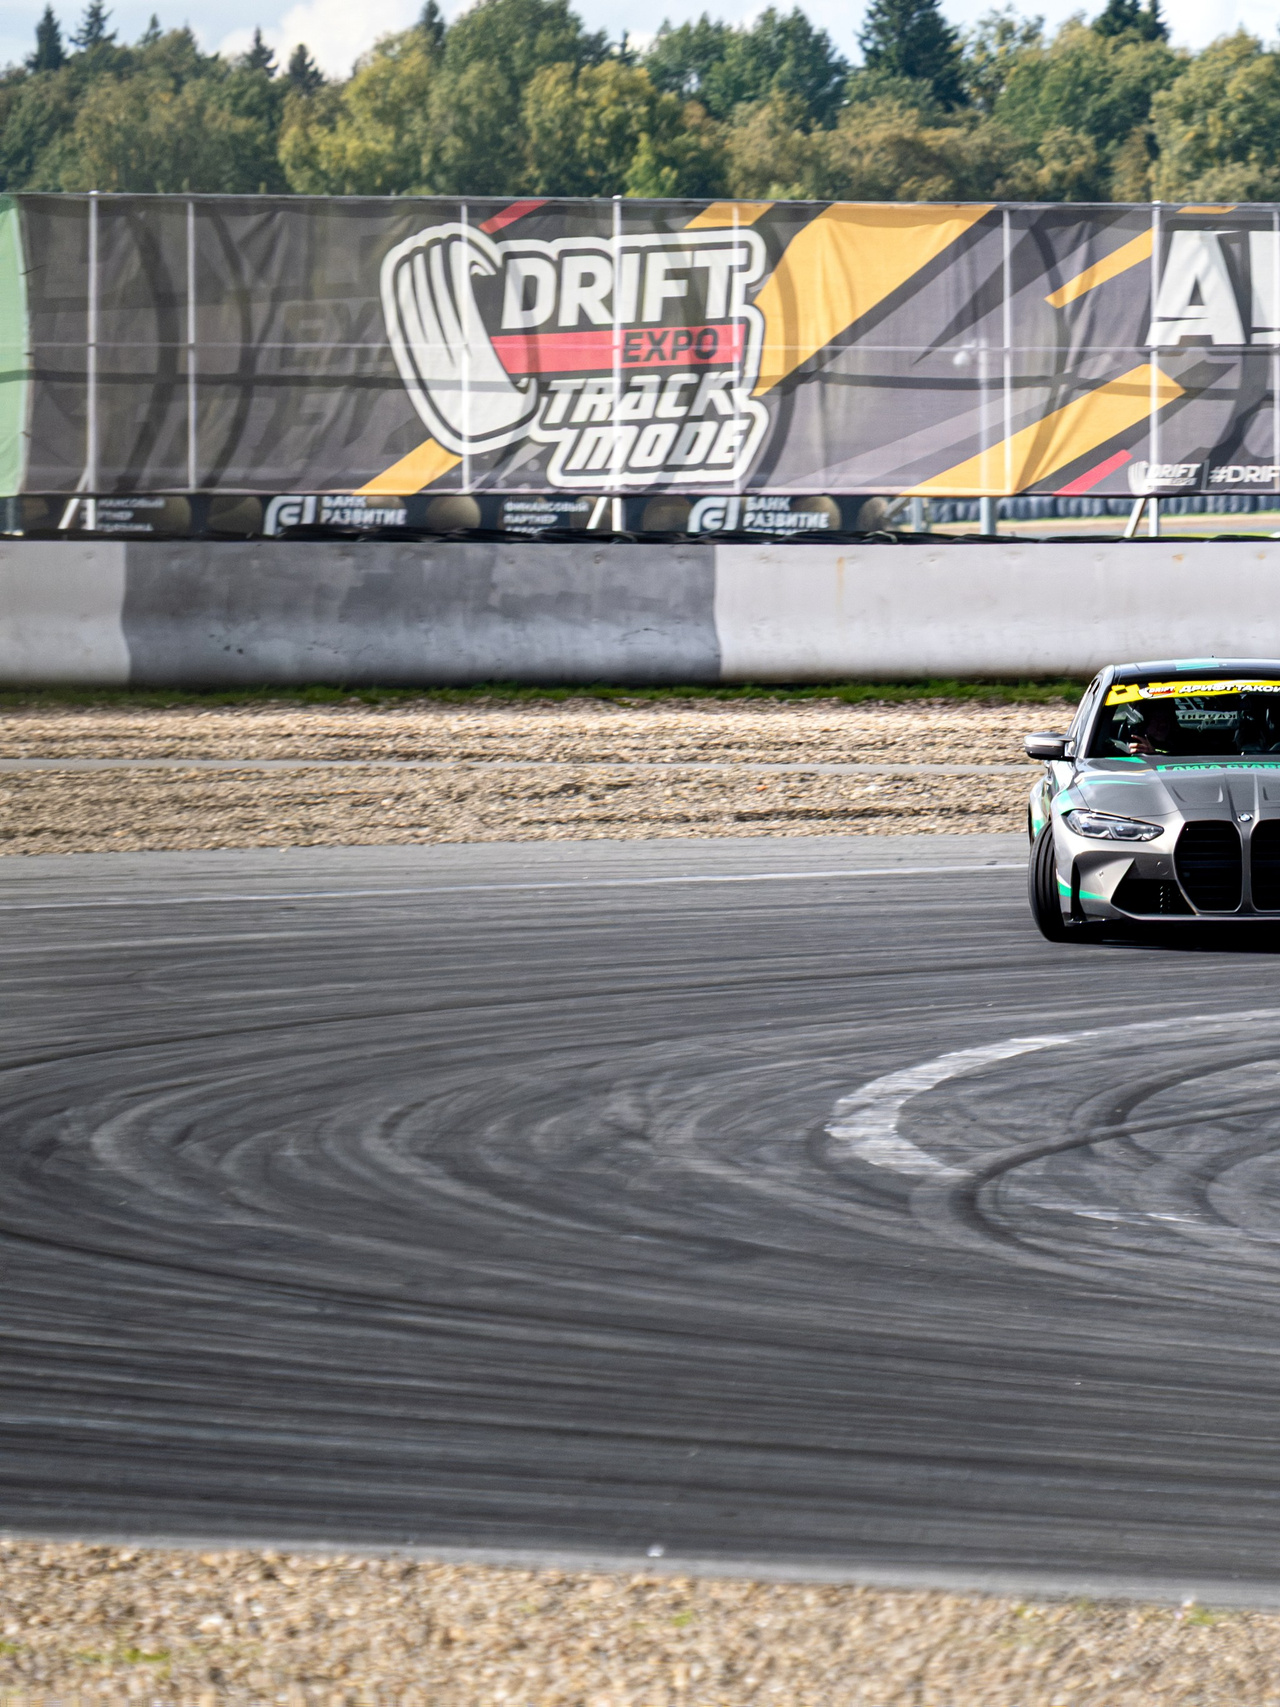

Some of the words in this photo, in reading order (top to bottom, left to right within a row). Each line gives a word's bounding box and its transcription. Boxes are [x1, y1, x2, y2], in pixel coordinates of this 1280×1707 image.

[501, 248, 749, 330] DRIFT
[622, 327, 719, 364] EXPO
[1146, 463, 1202, 478] DRIFT
[745, 497, 791, 511] БАНК
[320, 508, 407, 525] РАЗВИТИЕ
[742, 511, 830, 528] РАЗВИТИЕ
